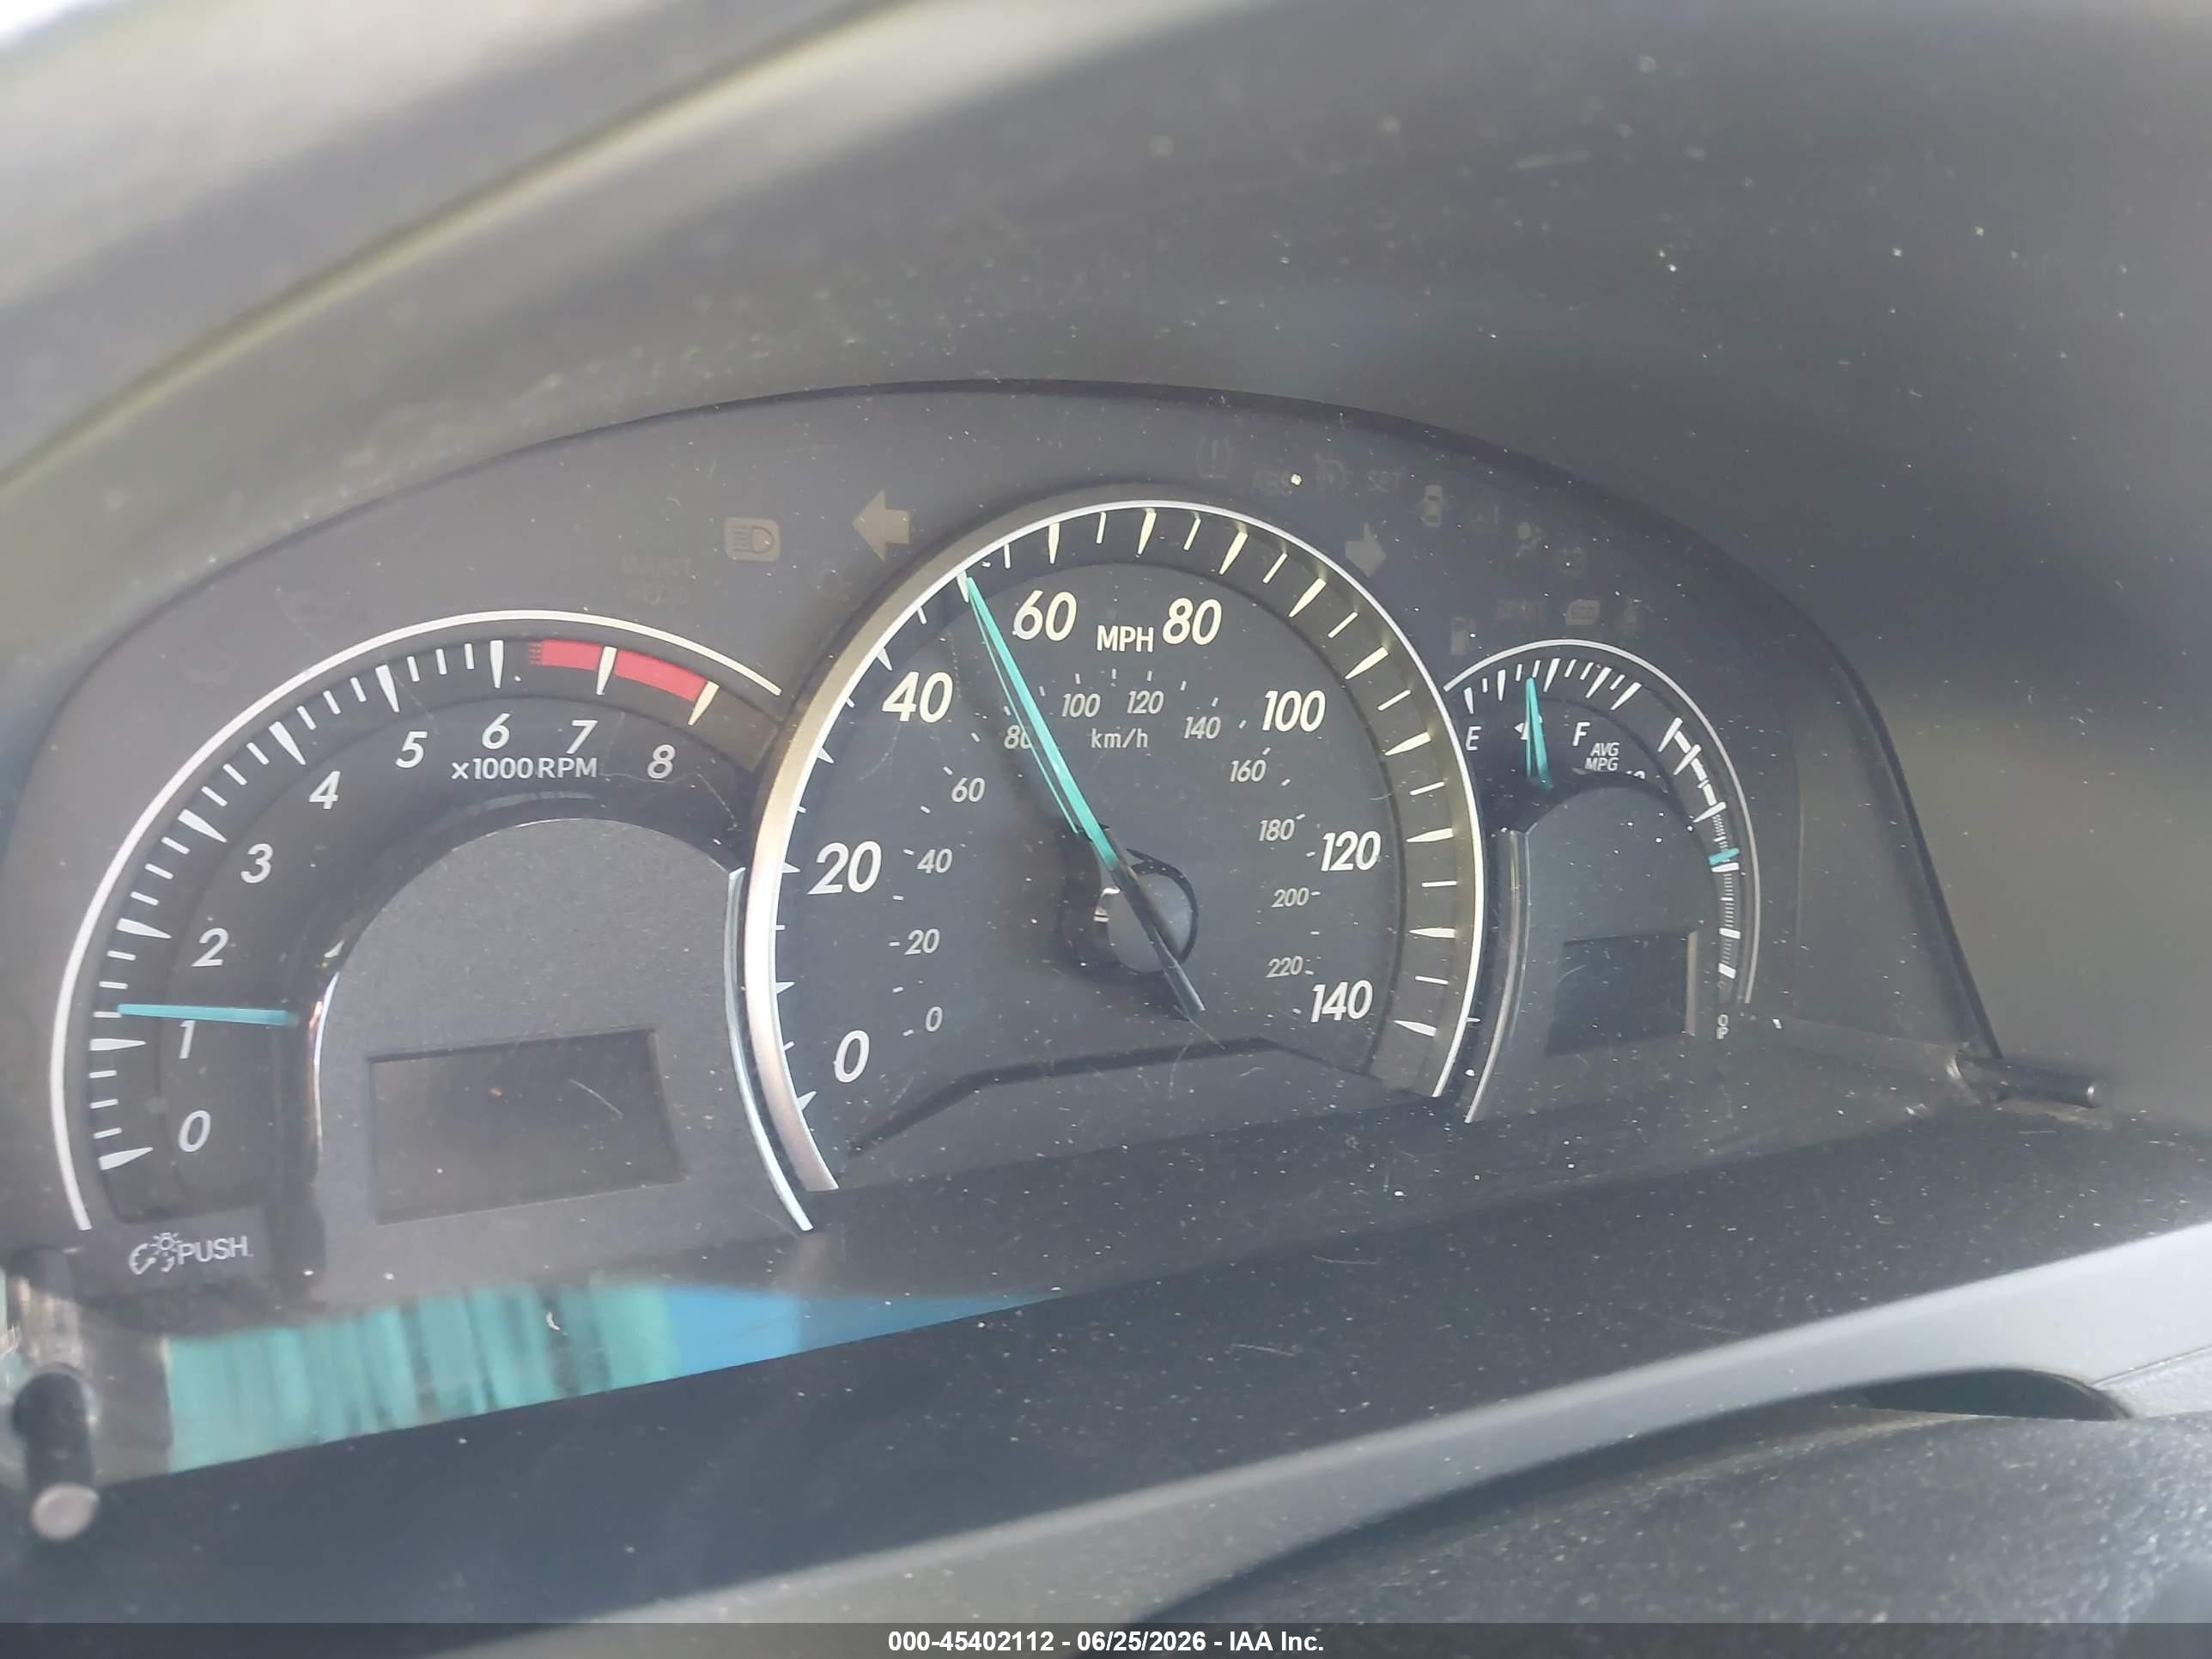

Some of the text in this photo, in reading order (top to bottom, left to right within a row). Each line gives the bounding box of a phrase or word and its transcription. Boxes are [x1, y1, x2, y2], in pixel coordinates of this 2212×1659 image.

[1013, 590, 1077, 641] 60
[1163, 599, 1221, 645] 80
[1097, 625, 1153, 652] MPH
[883, 672, 952, 722] 40
[1062, 694, 1100, 717] 100
[1127, 690, 1164, 714] 120
[1262, 690, 1325, 732] 100
[483, 714, 509, 749] 6
[567, 720, 598, 753] 7
[1091, 728, 1147, 748] km/h
[1184, 717, 1220, 738] 140
[1466, 726, 1481, 750] E
[1573, 722, 1590, 745] F
[396, 732, 427, 768] 5
[648, 744, 675, 778] 8
[1590, 741, 1620, 757] AVG
[1231, 760, 1266, 781] 160
[1585, 757, 1619, 771] MPG
[309, 771, 340, 809] 4
[952, 778, 985, 802] 60
[1260, 819, 1294, 841] 180
[241, 843, 272, 883] 3
[917, 849, 952, 873] 40
[1322, 831, 1380, 871] 120
[808, 842, 881, 894] 20
[1272, 888, 1309, 907] 200
[192, 928, 228, 966] 2
[905, 929, 939, 954] 20
[1267, 956, 1303, 977] 220
[1311, 981, 1372, 1022] 140
[926, 1006, 942, 1031] 0
[179, 1020, 195, 1059] 1
[834, 1030, 869, 1082] 0
[179, 1110, 210, 1152] 0
[177, 1237, 247, 1264] PUSH
